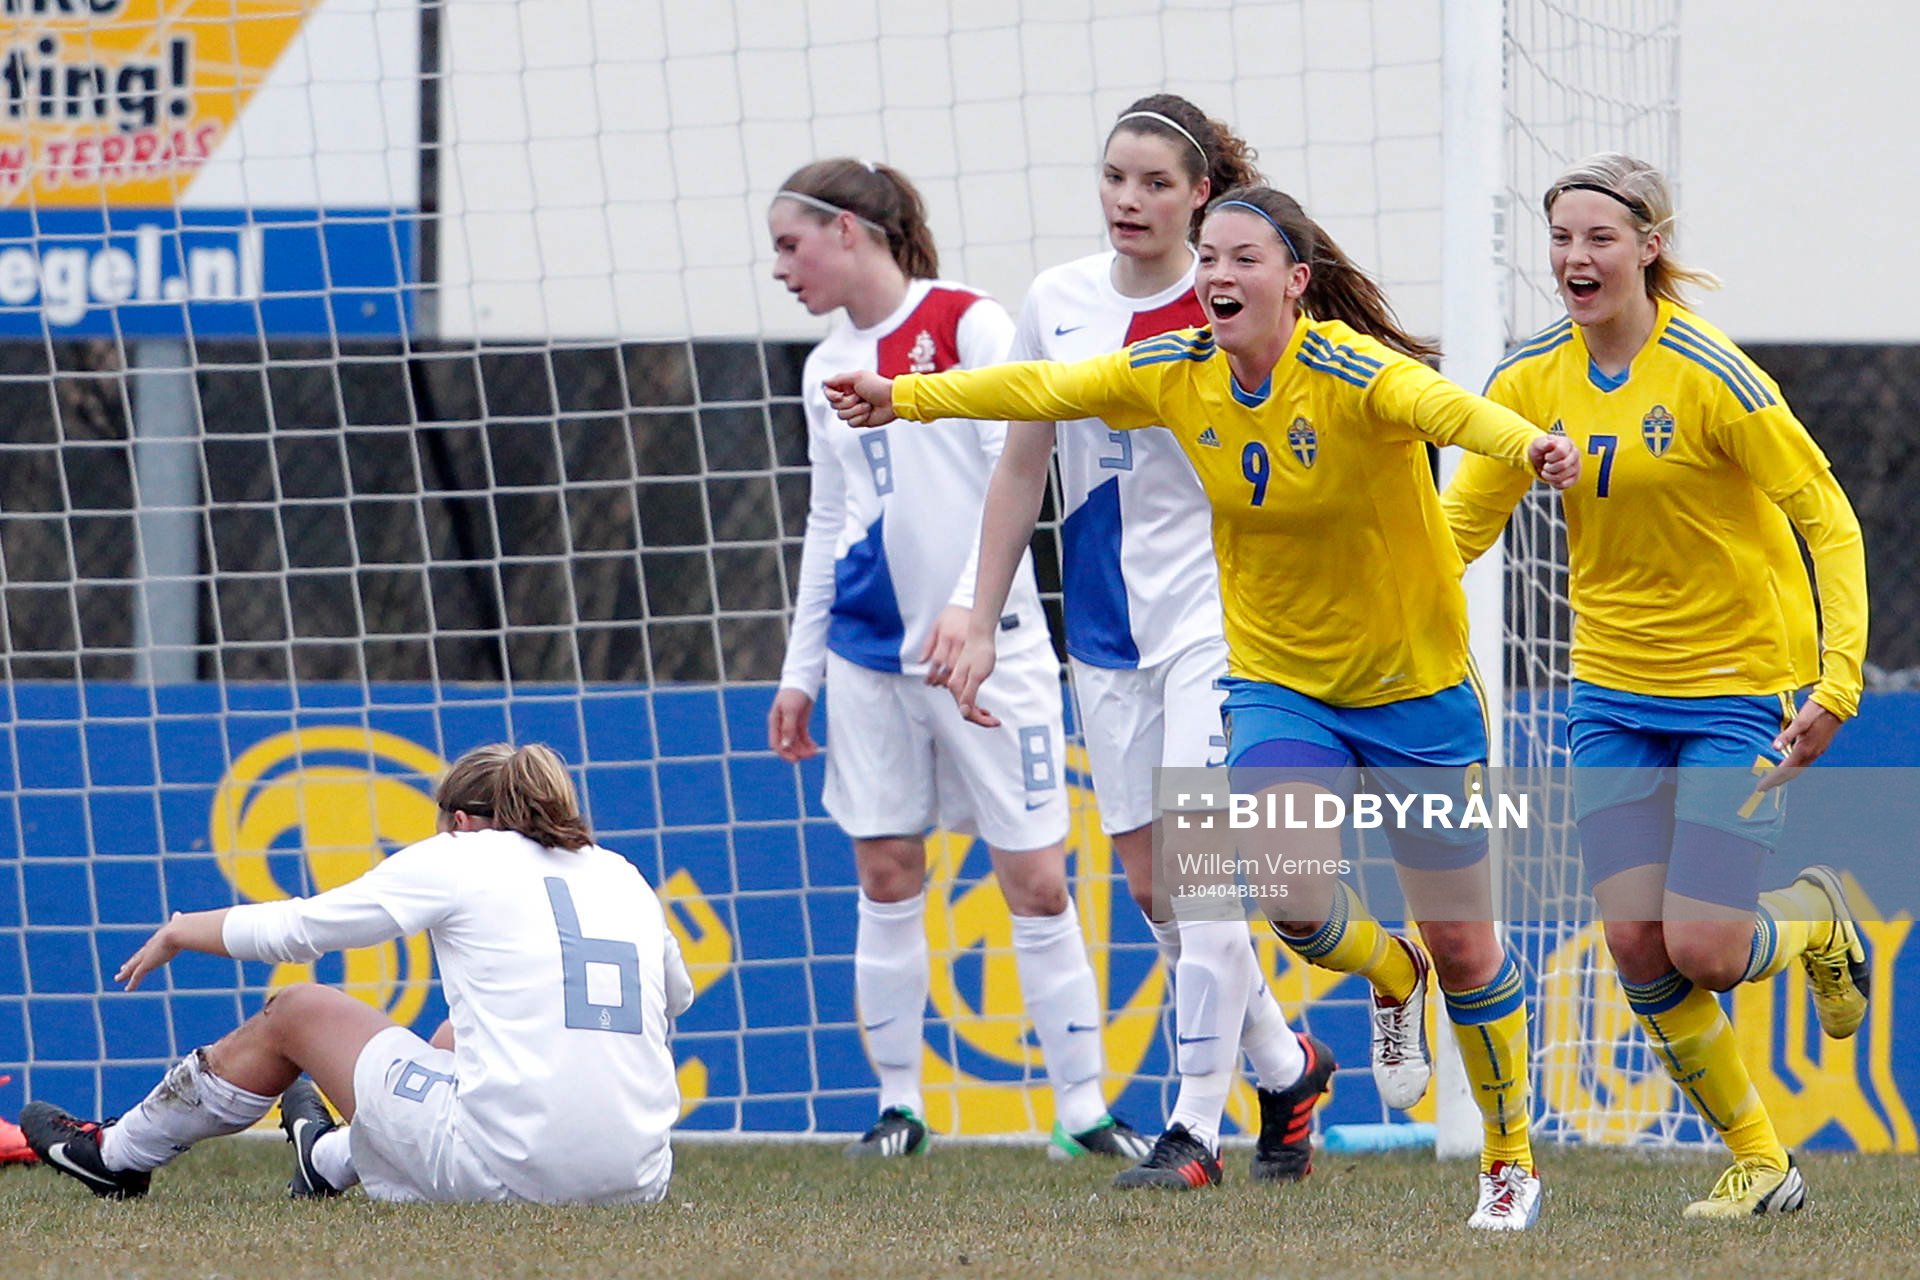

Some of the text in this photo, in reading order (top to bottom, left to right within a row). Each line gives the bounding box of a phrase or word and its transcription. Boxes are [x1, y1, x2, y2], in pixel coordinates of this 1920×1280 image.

[2, 36, 188, 131] ting!
[47, 125, 216, 183] TERRAS
[0, 224, 264, 326] egel.nl
[859, 429, 894, 497] 8
[1240, 441, 1272, 506] 9
[1586, 434, 1618, 498] 7
[1017, 724, 1057, 792] 8
[544, 876, 643, 1035] 6
